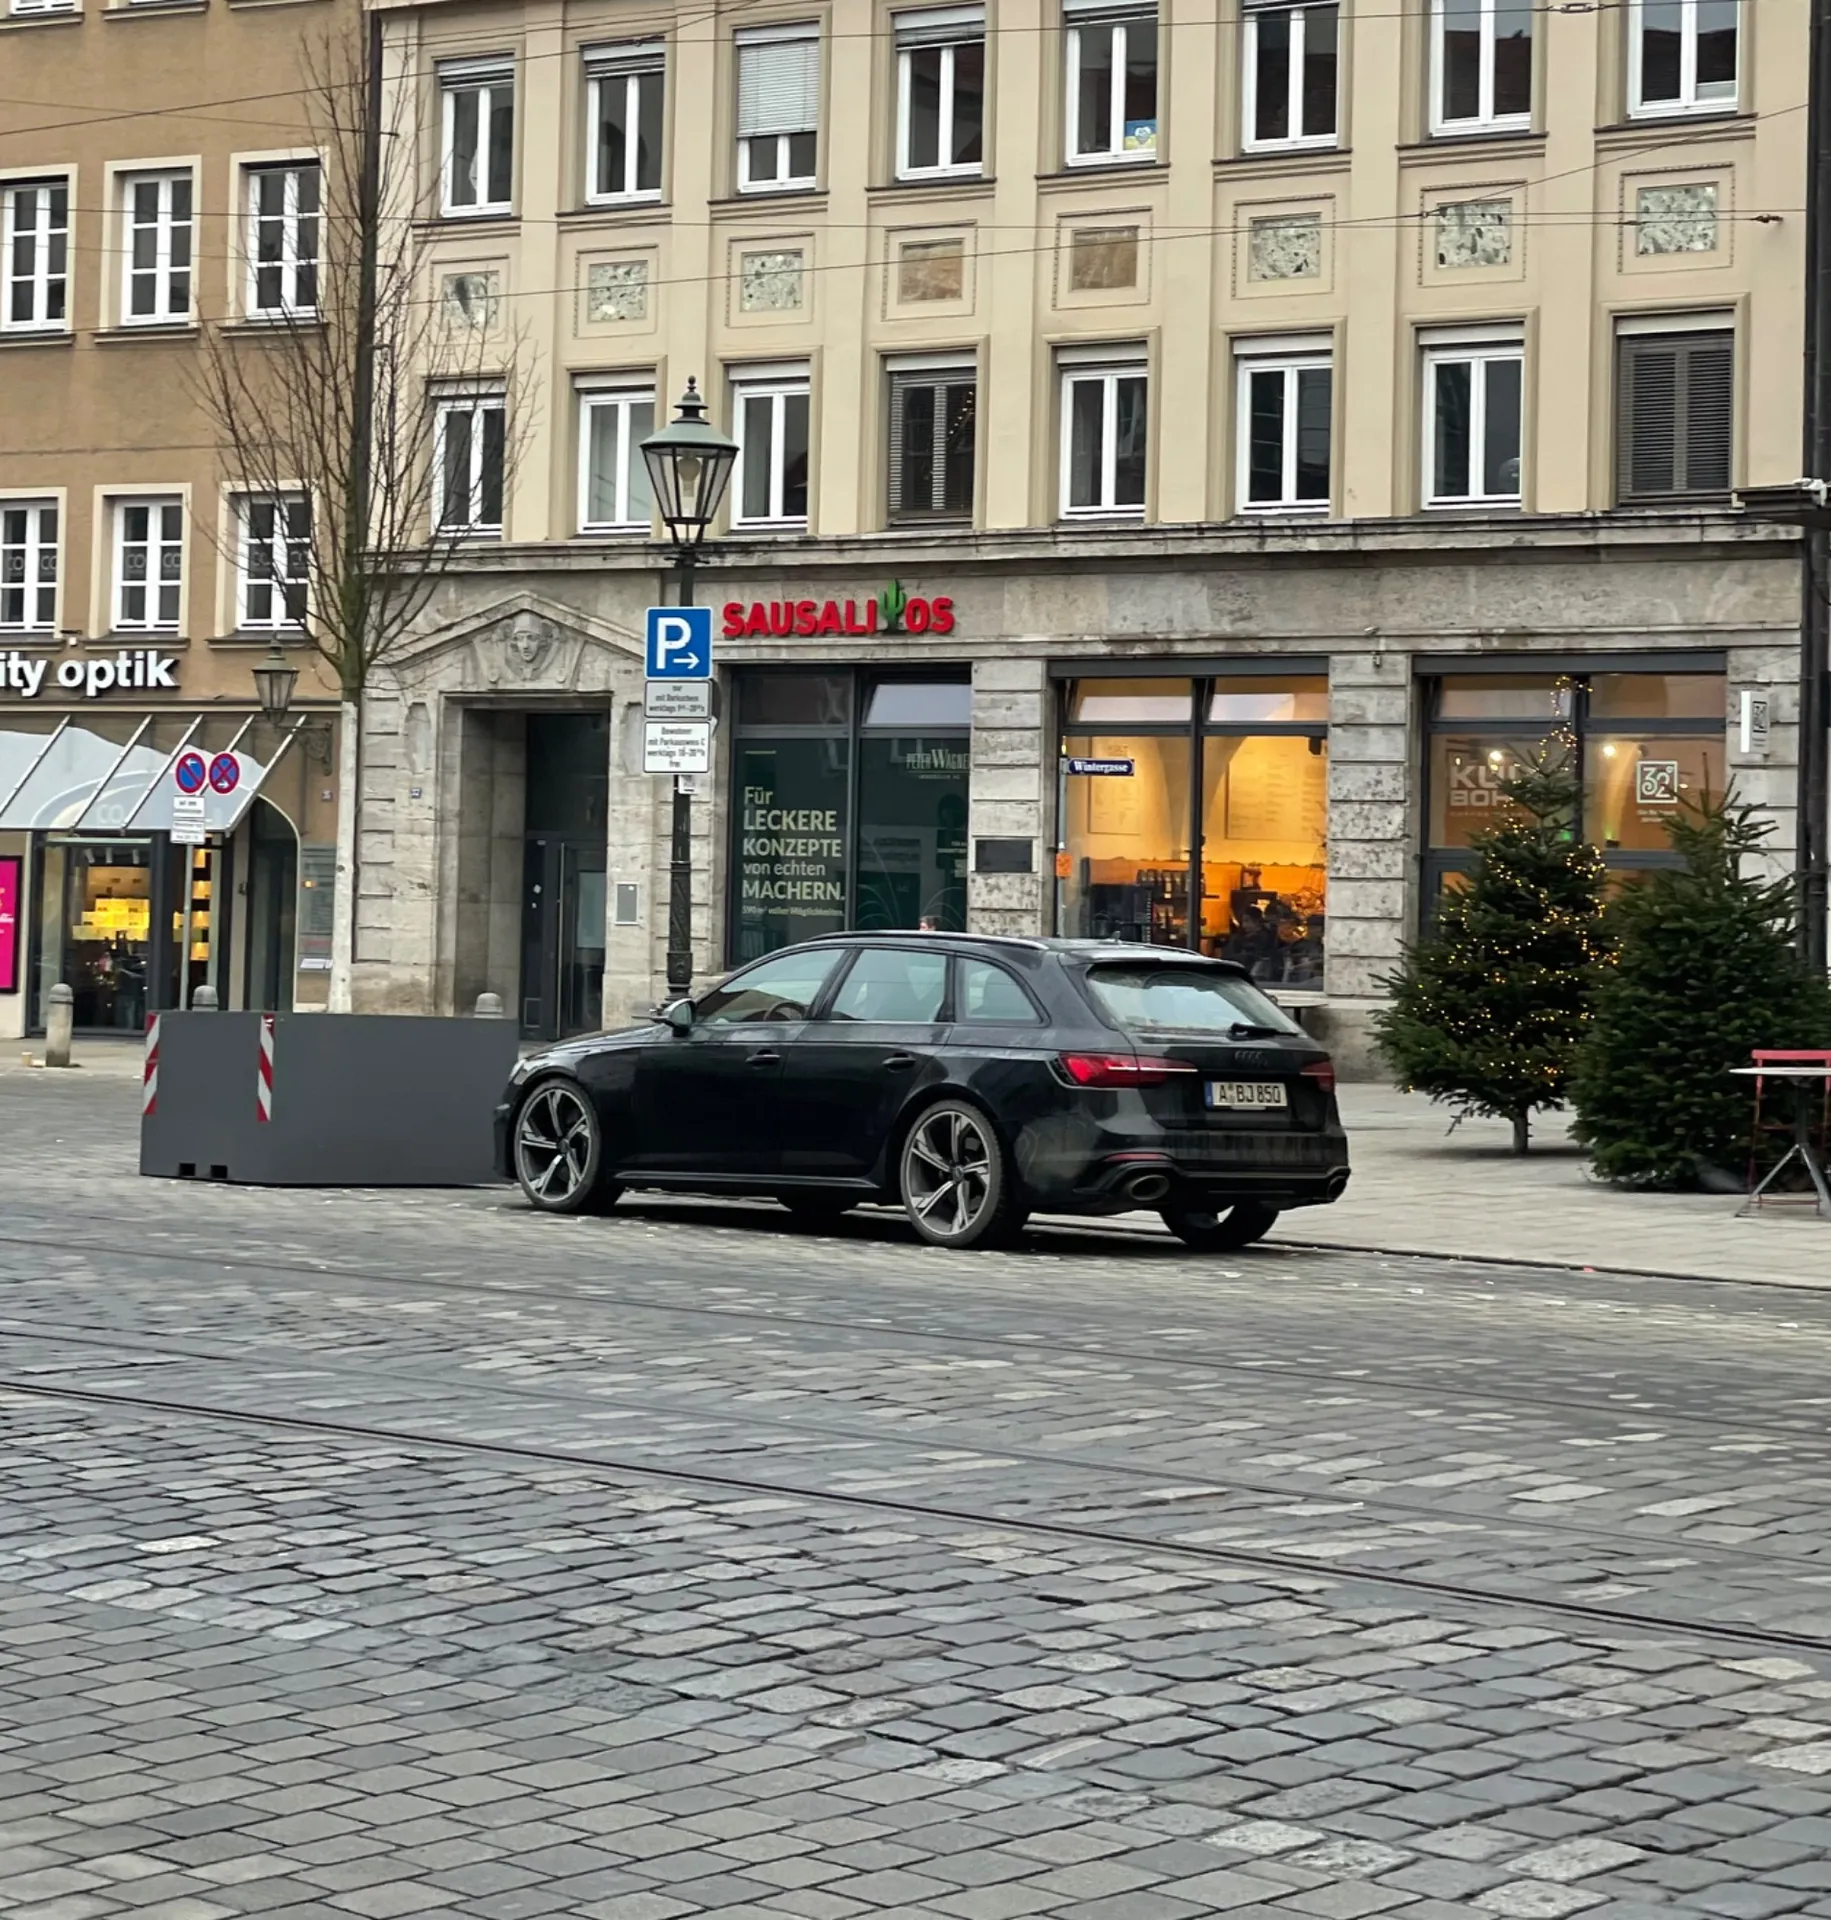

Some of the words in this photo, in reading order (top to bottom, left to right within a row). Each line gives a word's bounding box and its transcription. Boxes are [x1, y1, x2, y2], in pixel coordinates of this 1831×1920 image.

[656, 616, 692, 670] P
[0, 652, 47, 697] ity
[57, 650, 178, 697] optik
[931, 749, 969, 769] WAGNE
[1073, 760, 1129, 774] Wintergasse
[744, 786, 773, 805] Für
[743, 809, 837, 831] LECKERE
[742, 838, 842, 857] KONZEPTE
[743, 863, 771, 875] von
[774, 860, 826, 876] echten
[742, 880, 845, 901] MACHERN.
[1219, 1084, 1227, 1102] A
[1236, 1085, 1254, 1103] BJ
[1257, 1085, 1281, 1103] 850
